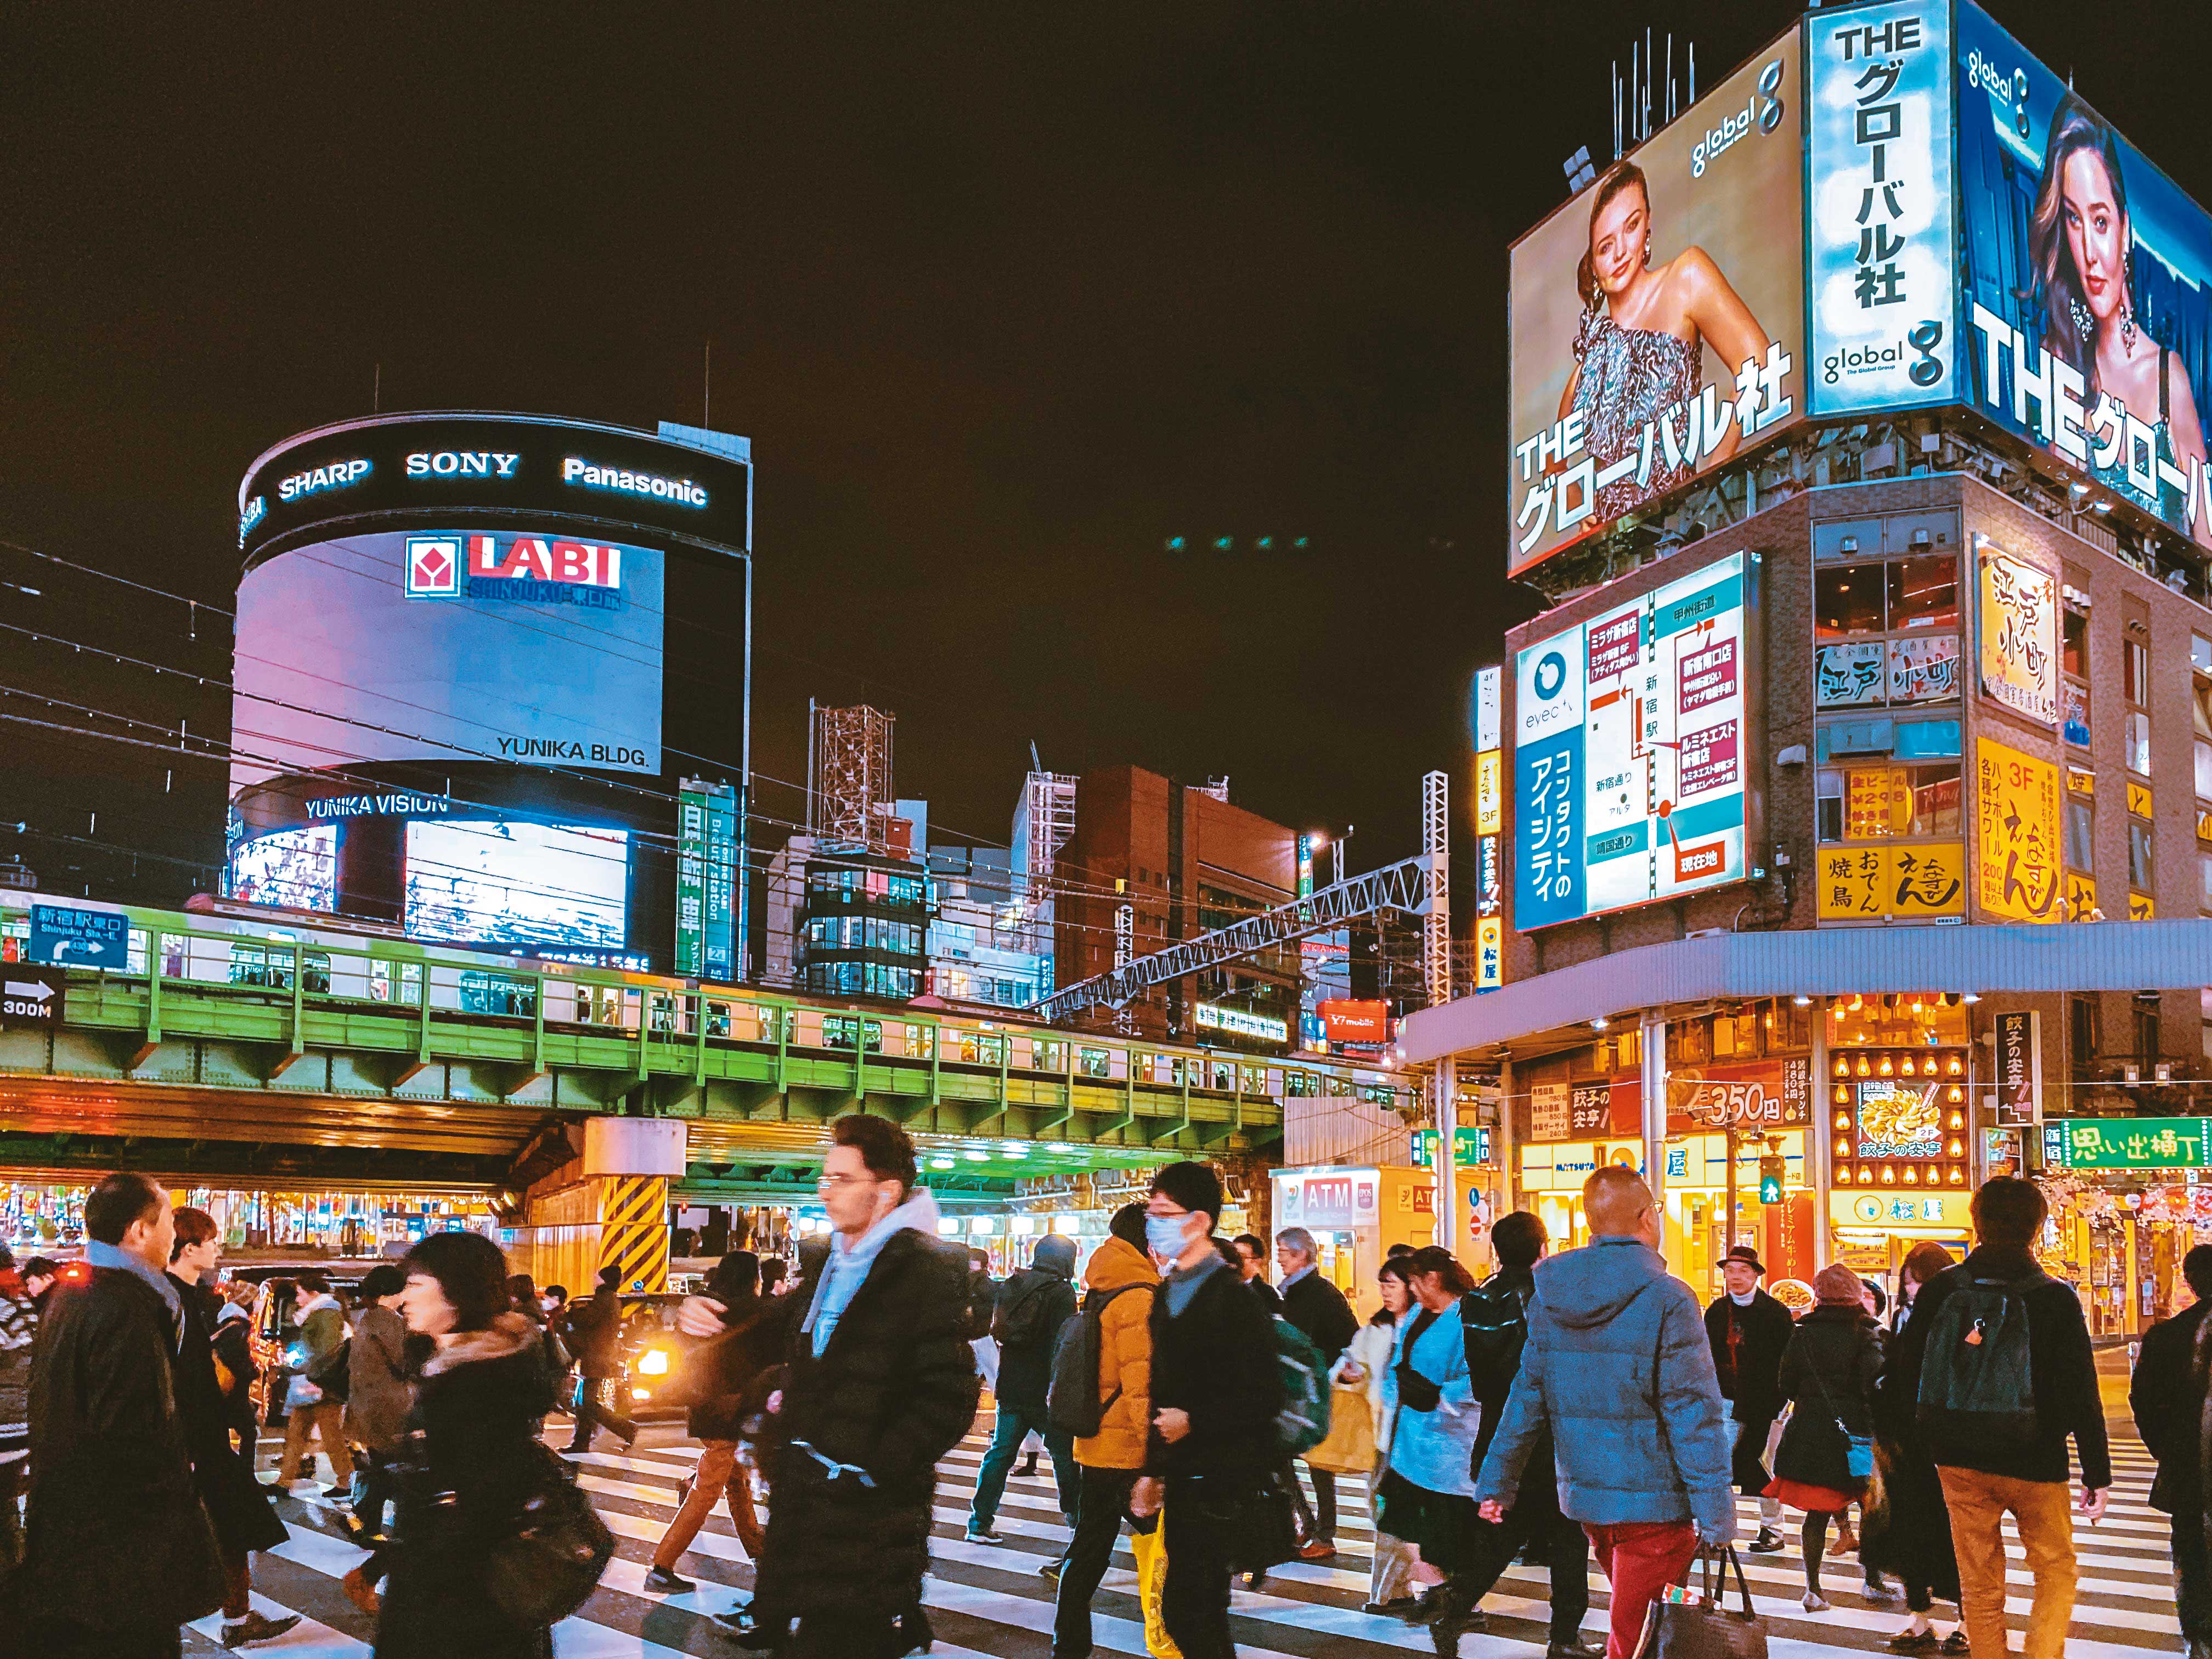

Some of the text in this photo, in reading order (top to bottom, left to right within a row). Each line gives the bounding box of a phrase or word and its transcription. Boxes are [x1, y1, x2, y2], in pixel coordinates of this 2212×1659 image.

[1836, 17, 1921, 59] THE
[1968, 50, 2012, 101] global
[1692, 95, 1755, 178] global
[1854, 59, 1906, 309] グローバル社
[1824, 341, 1903, 384] global
[1973, 301, 2087, 466] THE
[406, 453, 518, 476] SONY
[1516, 407, 1585, 482] THE
[1517, 341, 1792, 555] グローバル社
[279, 459, 369, 501] SHARP
[565, 458, 707, 506] Panasonic
[469, 535, 622, 589] LABI
[1673, 594, 1715, 622] 甲州街道
[1645, 675, 1659, 737] 新宿駅
[497, 737, 650, 768] YUNIKA BLDG.
[1681, 722, 1736, 753] ルミネエスト
[1596, 771, 1632, 793] 新宿通り
[2009, 761, 2034, 791] 3F
[305, 794, 448, 819] YUNIKA VISION
[1482, 810, 1497, 823] 3F
[1555, 749, 1571, 898] コンタクトの
[1981, 757, 1993, 855] 各種サワー
[1991, 761, 2003, 857] ハイボール
[1531, 755, 1553, 902] アイシティ
[1596, 834, 1633, 855] 靖国通り
[1680, 849, 1718, 873] 現在地
[1858, 851, 1880, 912] おでん
[1983, 862, 2002, 881] 200
[709, 872, 720, 921] station
[1829, 856, 1853, 908] 焼鳥
[38, 907, 121, 932] 新宿駅東口
[41, 923, 82, 937] Shinjuku
[1483, 947, 1497, 979] 松屋
[3, 1000, 52, 1018] 300M
[1573, 1089, 1610, 1108] 餃子の
[1711, 1083, 1780, 1124] 350円
[2045, 1128, 2062, 1160] 新宿
[2072, 1127, 2201, 1161] 思い出横丁
[1307, 1183, 1348, 1207] ATM
